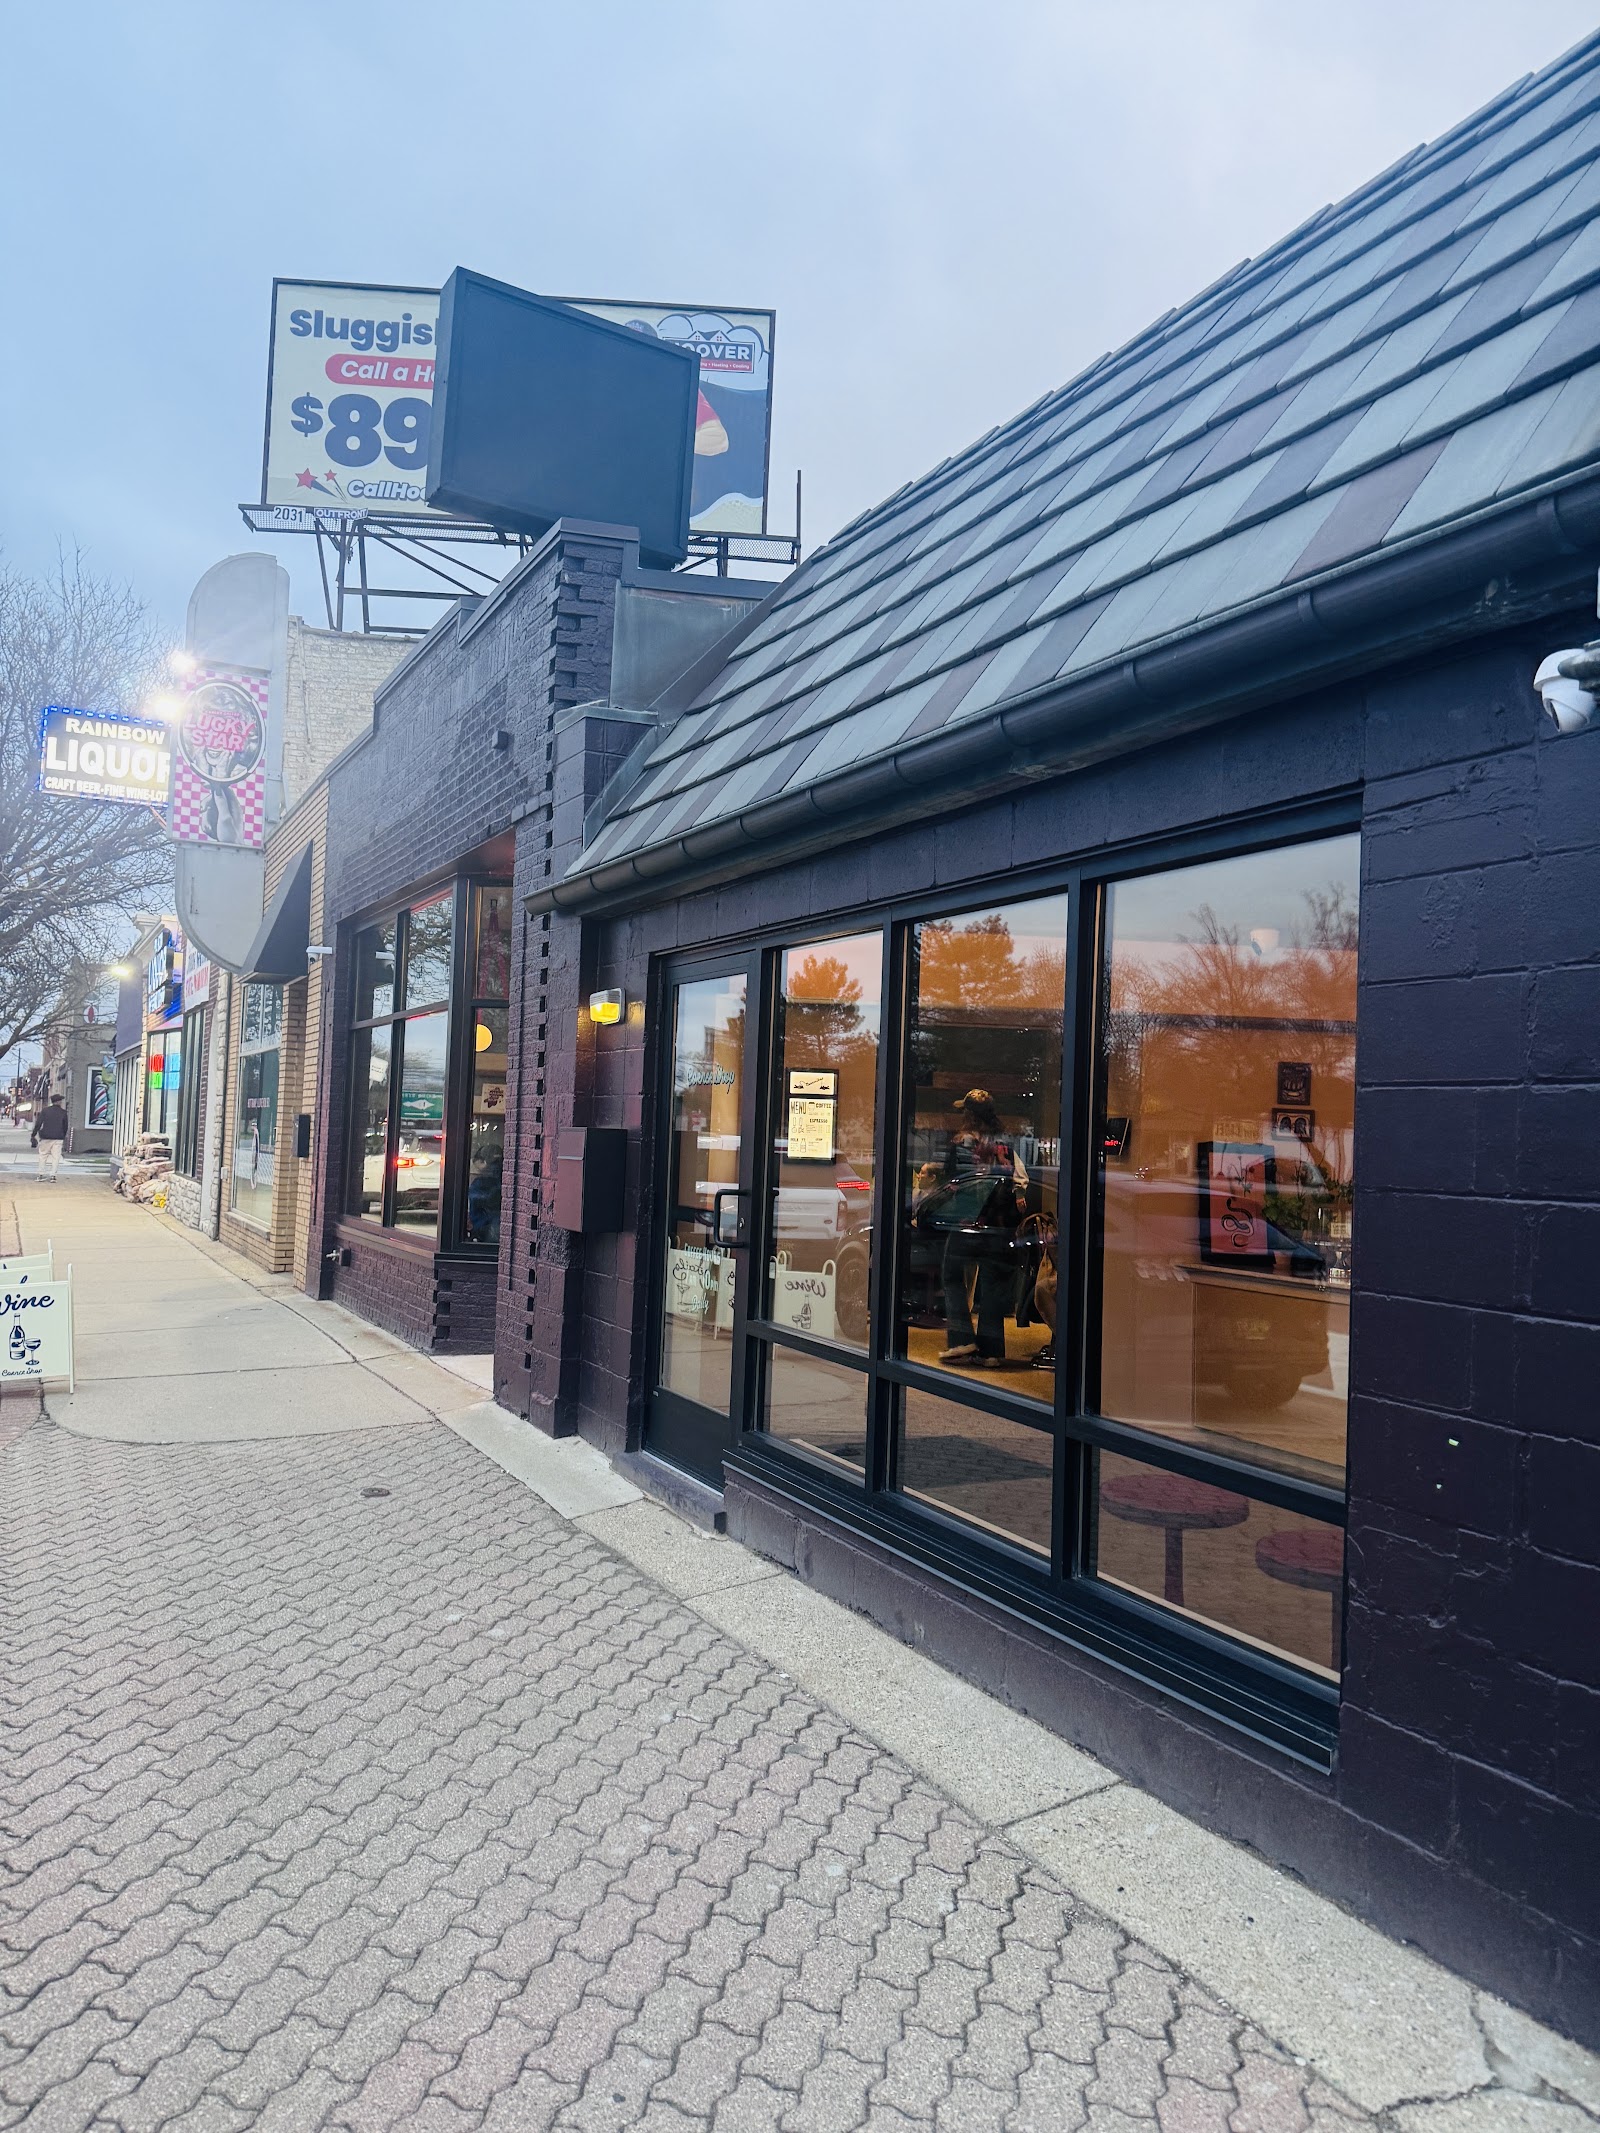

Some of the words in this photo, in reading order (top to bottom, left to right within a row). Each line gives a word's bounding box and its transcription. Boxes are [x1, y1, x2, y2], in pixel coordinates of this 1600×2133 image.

[289, 309, 439, 353] Sluggis
[675, 342, 750, 360] OOVER
[341, 361, 389, 379] Call
[393, 367, 409, 381] a
[274, 508, 306, 522] 2031
[316, 508, 368, 519] OUTFRONT
[65, 717, 166, 745] RAINBOW
[184, 711, 257, 739] LUCKY
[190, 728, 244, 753] STAR
[45, 777, 76, 791] CRAFT
[76, 779, 101, 794] BEER
[104, 783, 126, 797] FINE
[790, 1101, 807, 1115] MENU
